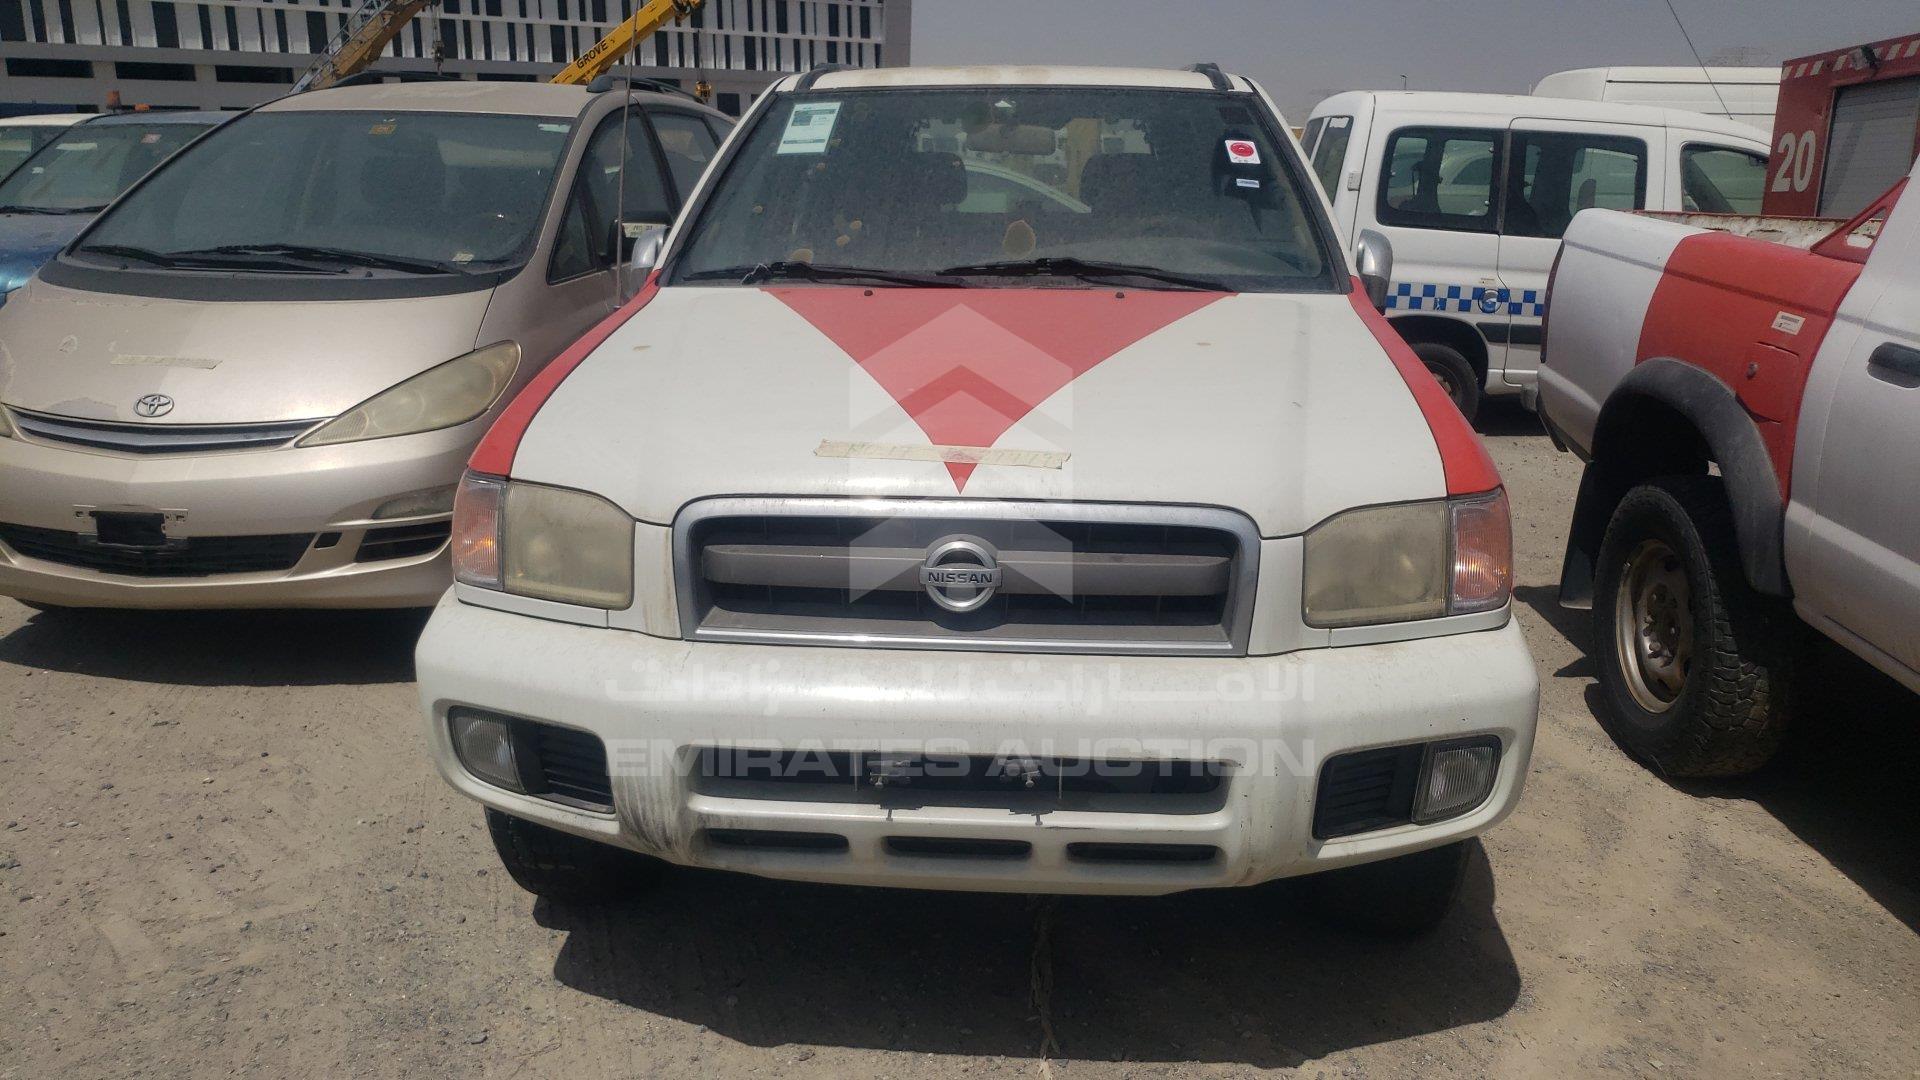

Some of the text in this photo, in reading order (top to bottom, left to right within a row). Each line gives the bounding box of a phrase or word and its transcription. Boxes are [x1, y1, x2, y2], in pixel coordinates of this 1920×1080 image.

[576, 40, 608, 69] GROVE
[1772, 130, 1816, 193] 20
[928, 571, 993, 584] NISSAN
